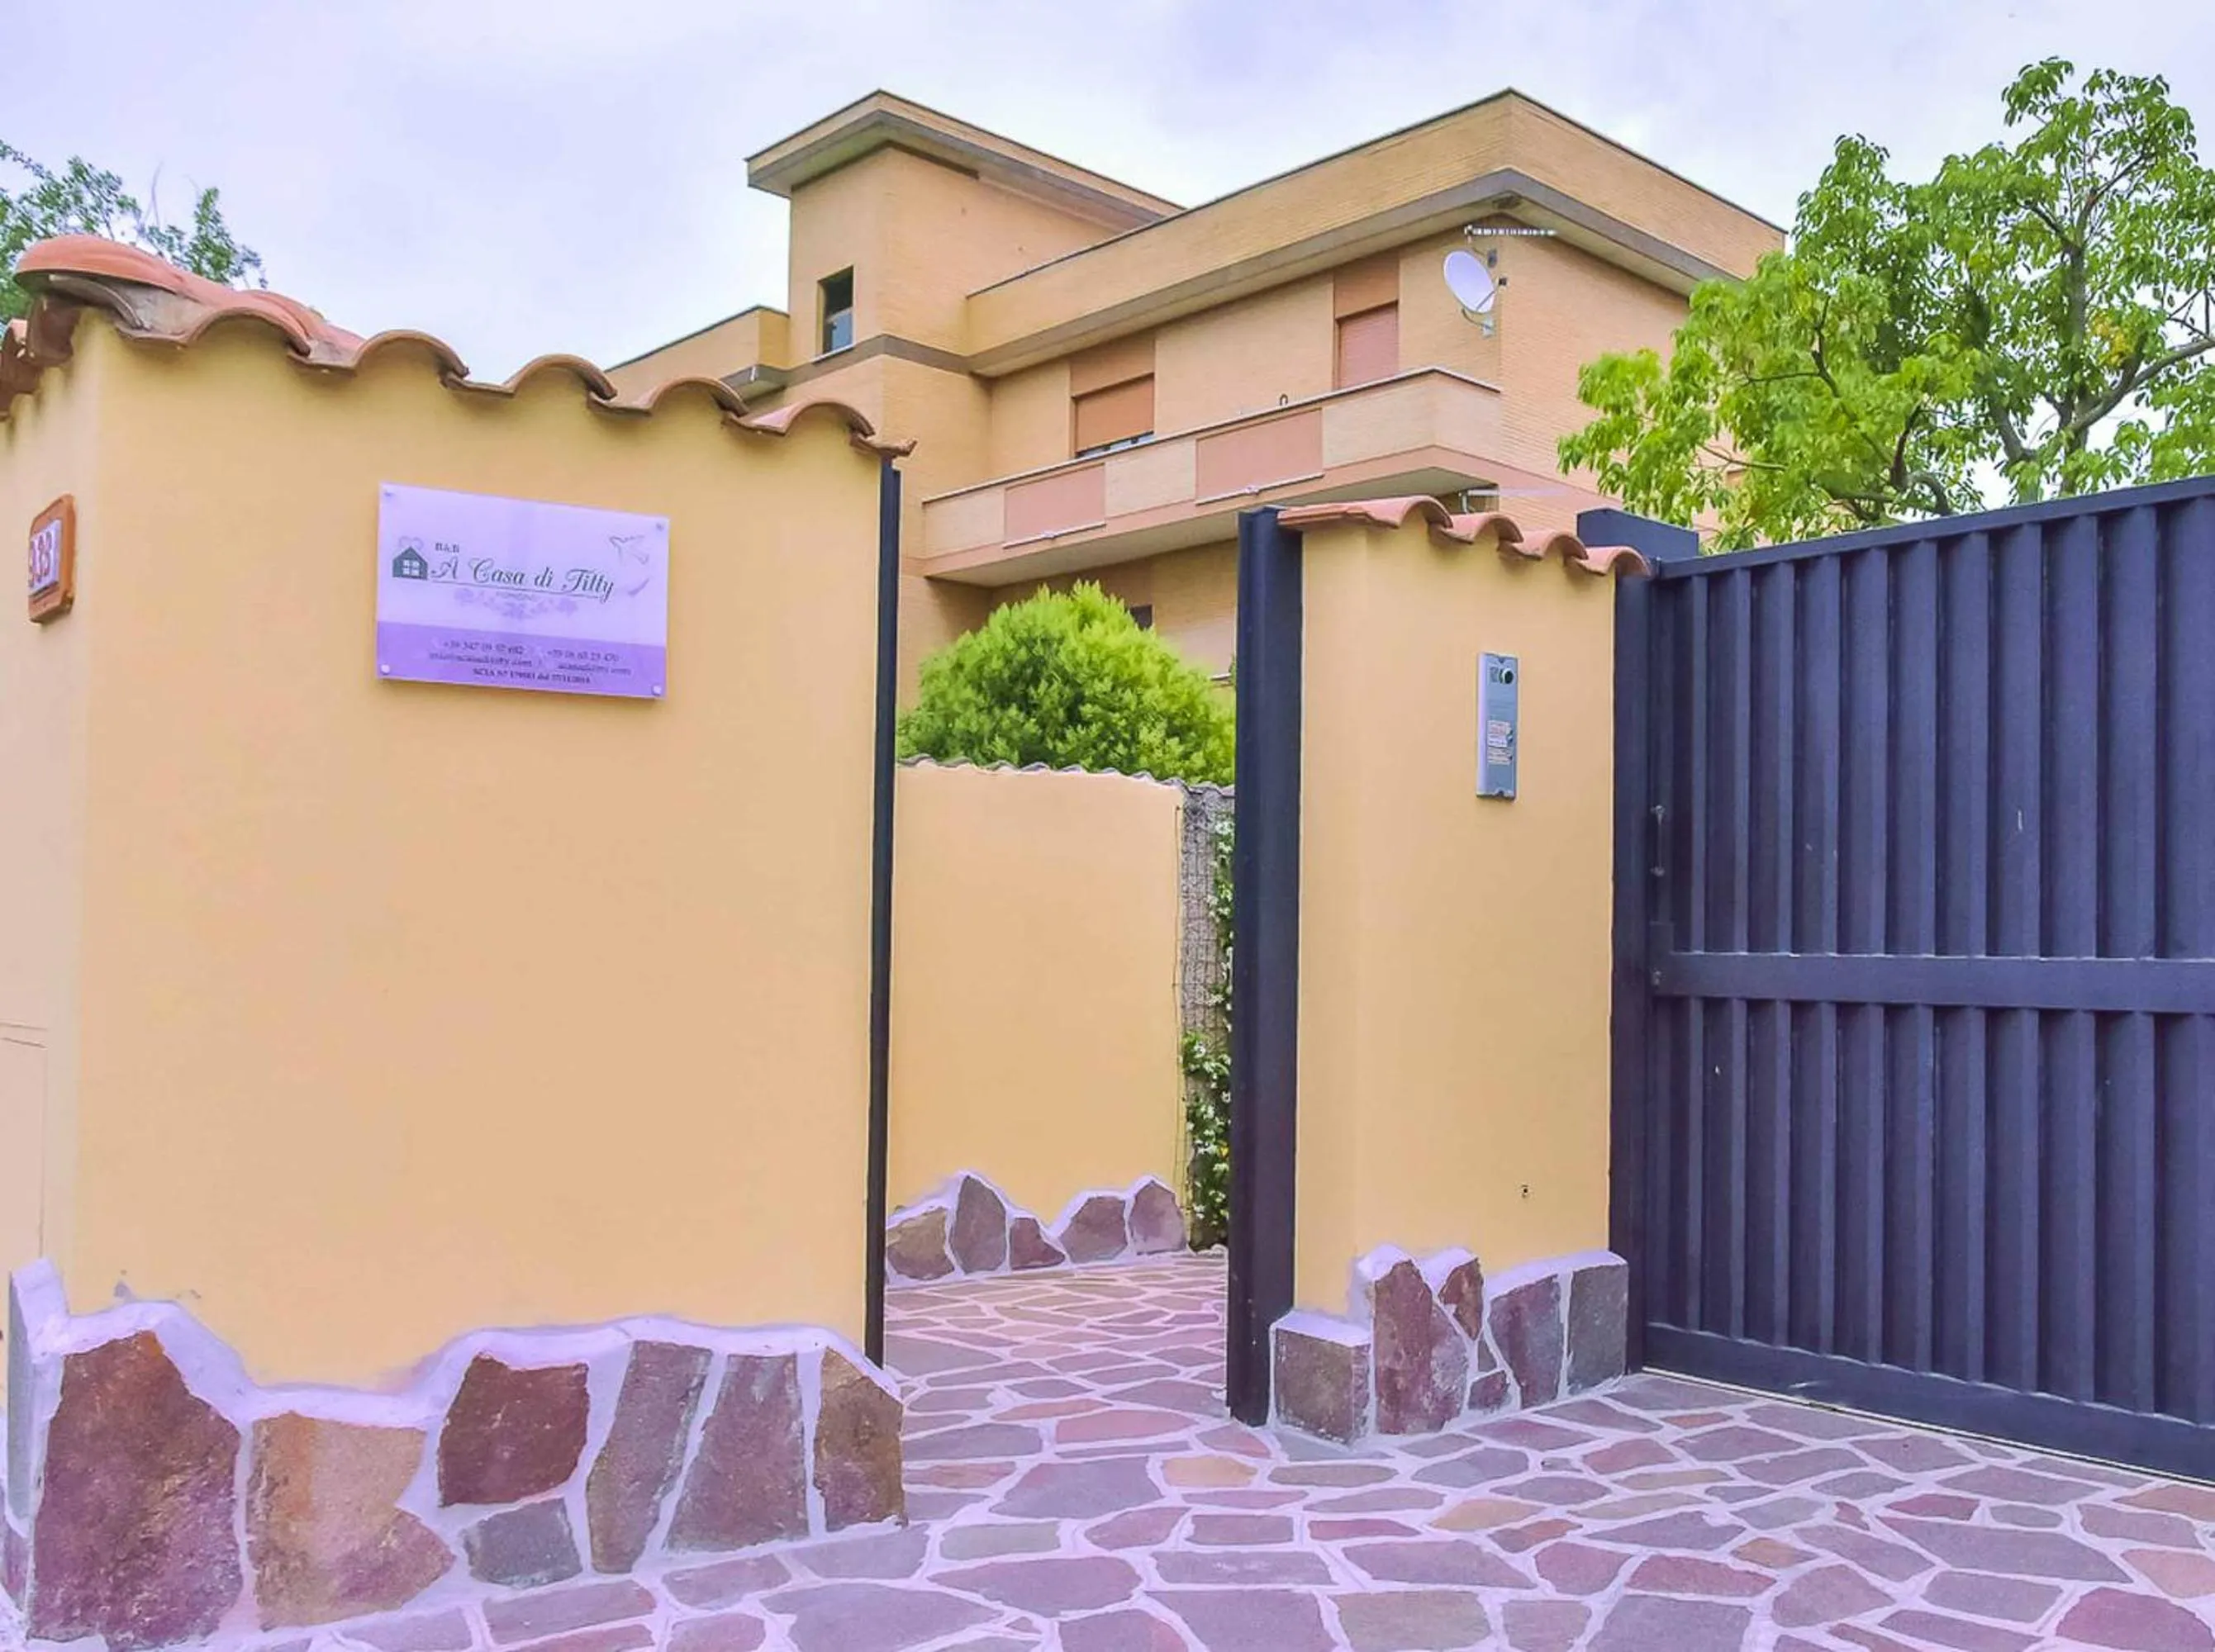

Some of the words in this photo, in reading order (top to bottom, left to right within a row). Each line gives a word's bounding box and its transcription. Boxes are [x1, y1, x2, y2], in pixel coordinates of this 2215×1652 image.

[430, 557, 459, 580] A
[468, 558, 525, 583] Casa
[534, 567, 554, 587] di
[561, 568, 614, 604] Titty
